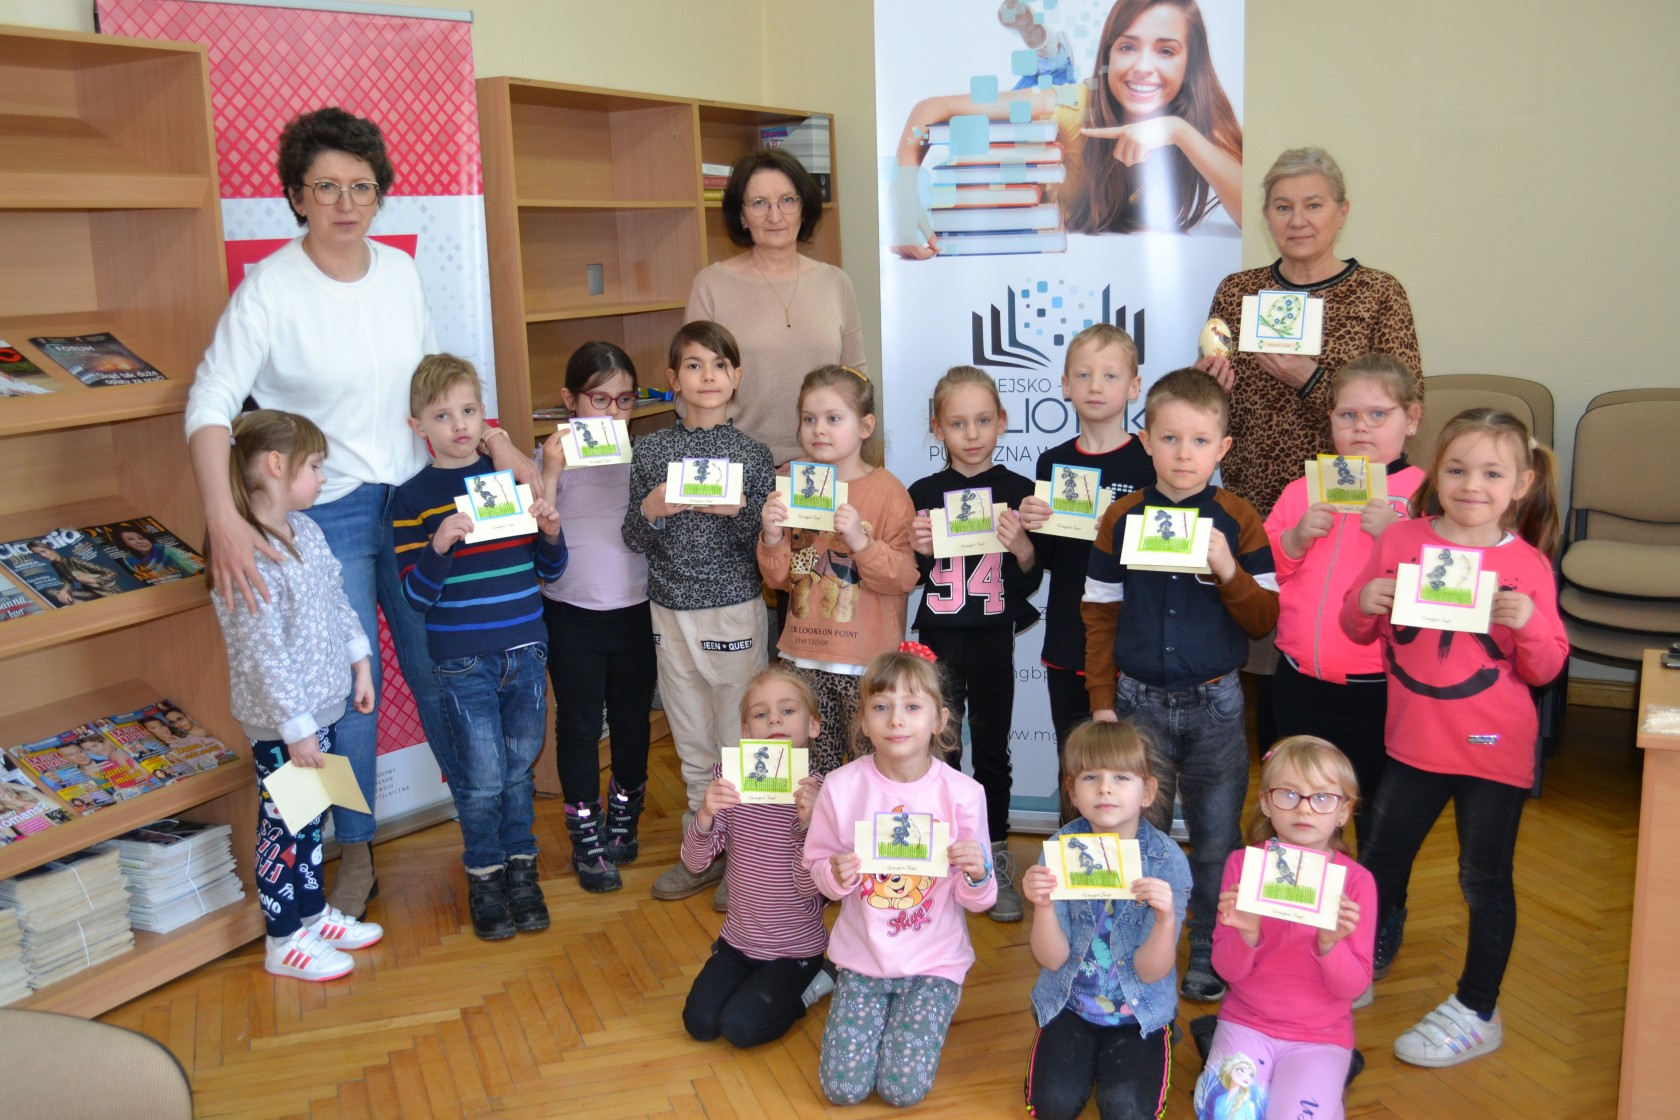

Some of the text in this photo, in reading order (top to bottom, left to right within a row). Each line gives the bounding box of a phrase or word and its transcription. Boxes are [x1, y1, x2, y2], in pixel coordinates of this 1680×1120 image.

[994, 378, 1052, 393] EJSKO
[0, 529, 82, 560] Cladia
[926, 551, 1005, 615] 94
[834, 629, 858, 639] POINT
[25, 751, 62, 765] DOBRY
